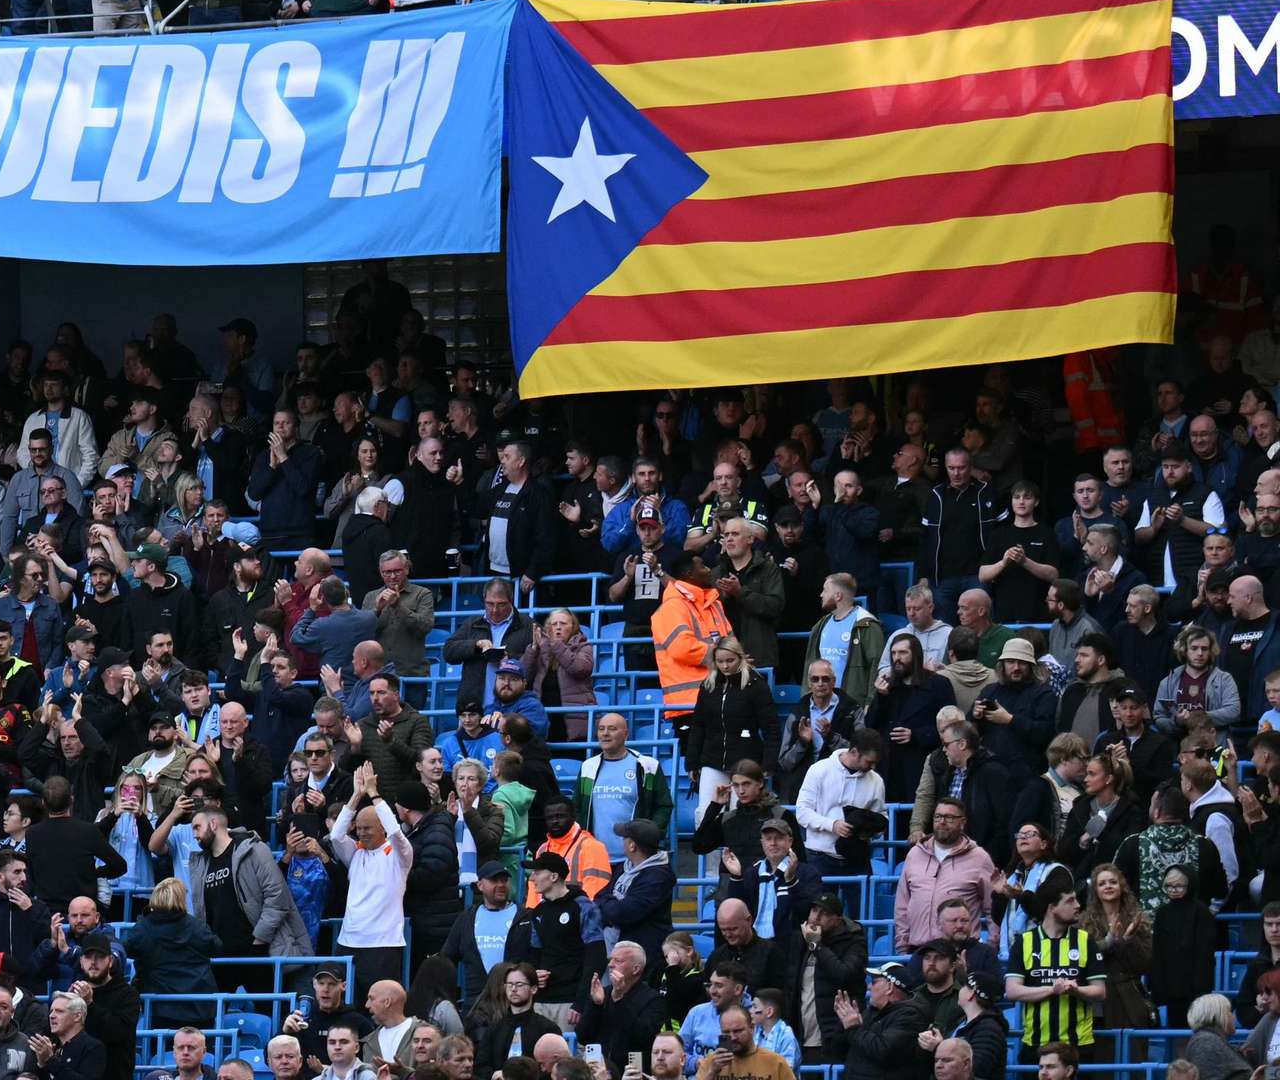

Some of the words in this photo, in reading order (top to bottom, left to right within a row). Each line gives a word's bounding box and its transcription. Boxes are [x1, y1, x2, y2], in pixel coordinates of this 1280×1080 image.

[328, 31, 466, 198] !!!
[643, 583, 652, 596] L
[1030, 968, 1080, 978] ETIHAD
